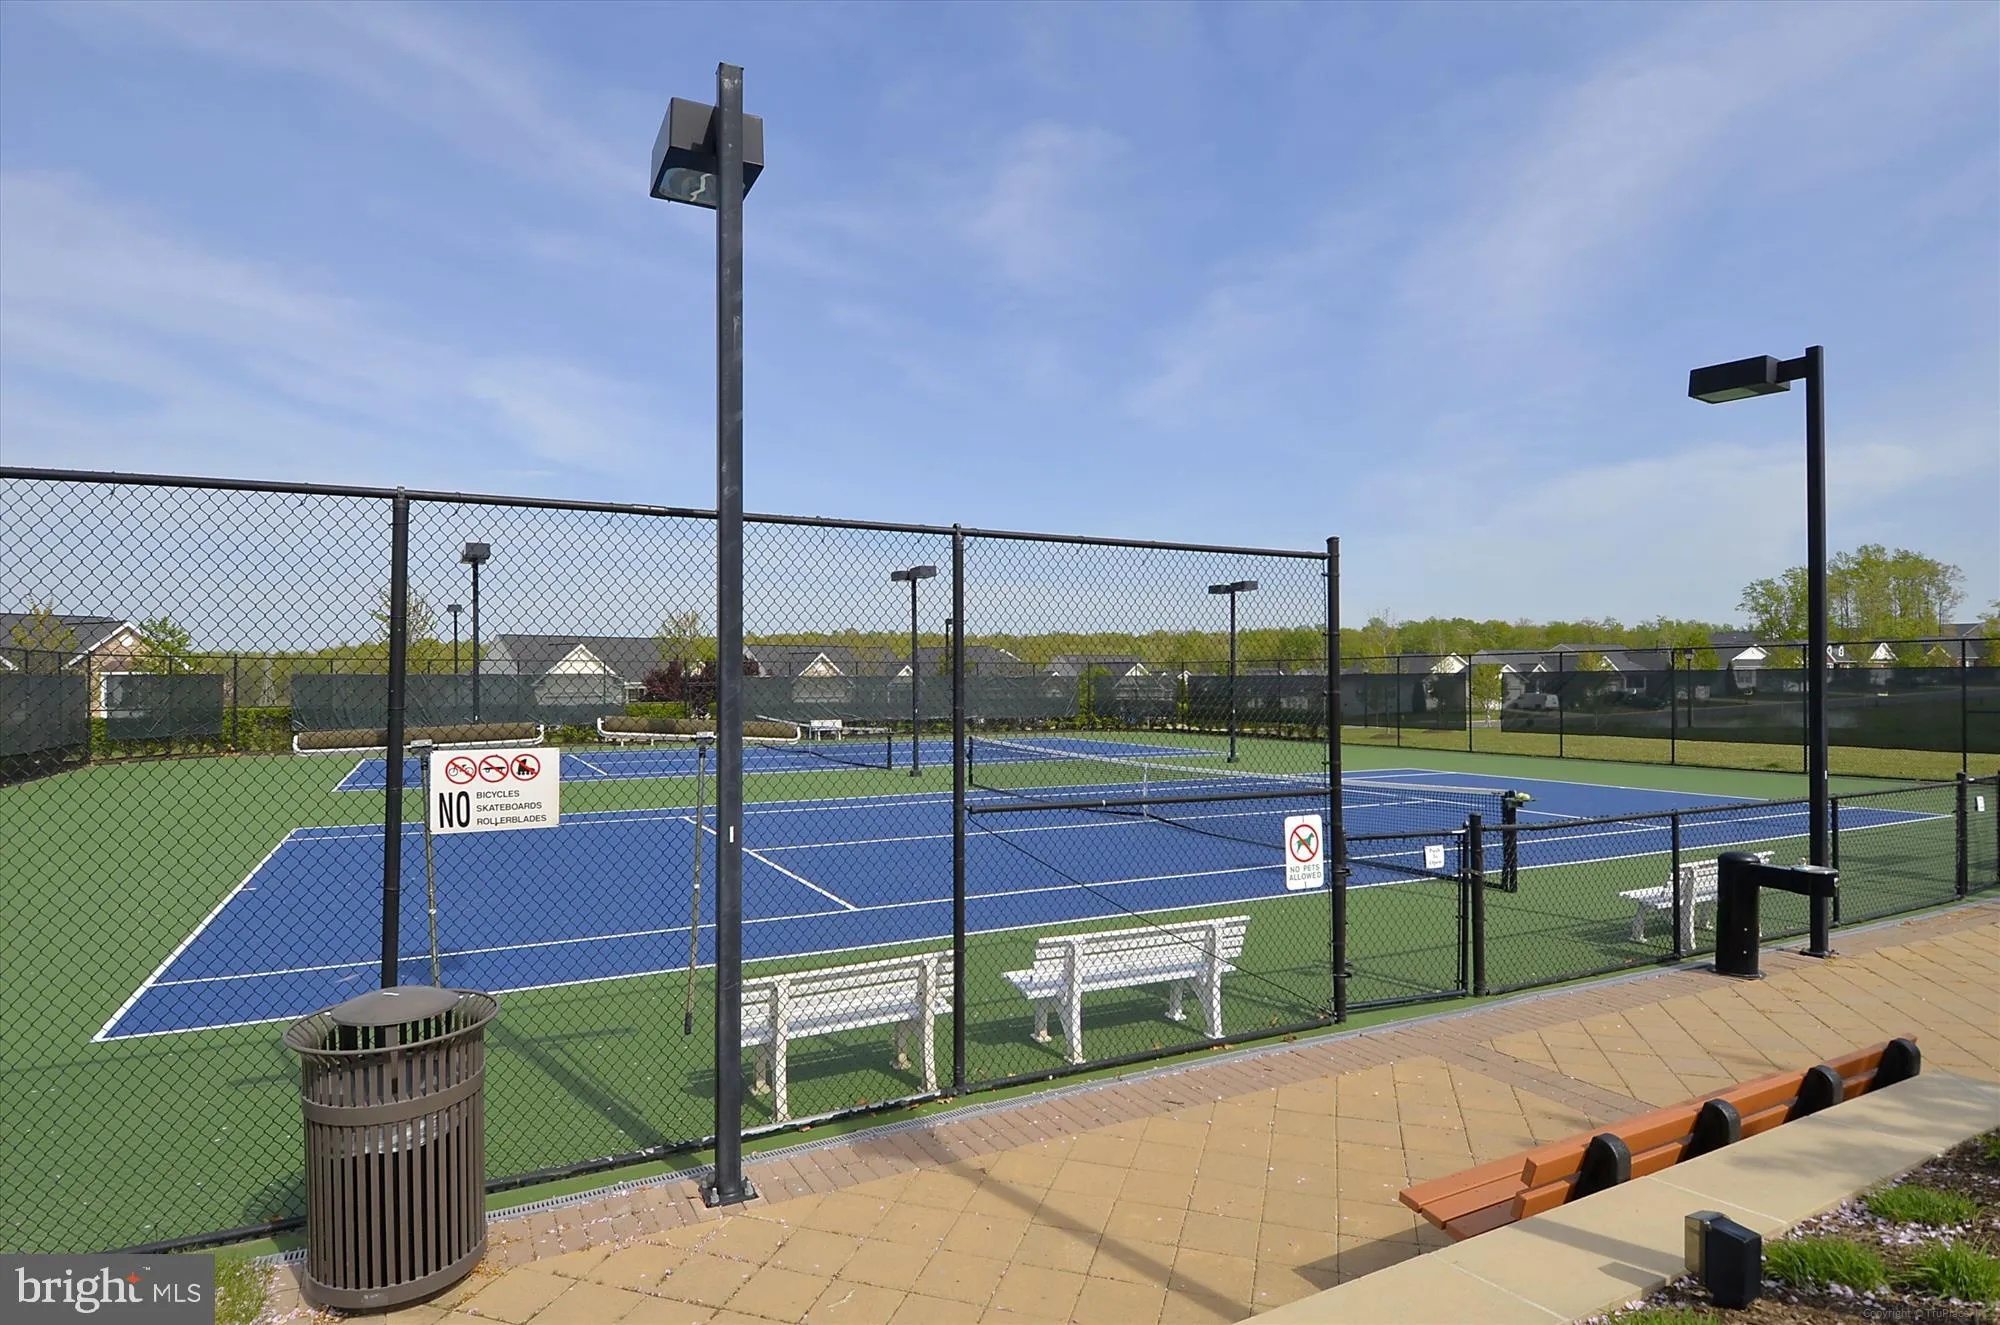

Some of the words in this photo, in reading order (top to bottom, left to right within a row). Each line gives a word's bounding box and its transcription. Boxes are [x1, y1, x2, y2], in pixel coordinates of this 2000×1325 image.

[476, 790, 520, 799] BICYCLES
[439, 791, 470, 828] NO
[476, 801, 542, 812] SKATEBOARDS
[477, 815, 547, 826] ROLLERBLADES
[1303, 864, 1320, 872] PETS
[1289, 871, 1322, 881] ALLOWED
